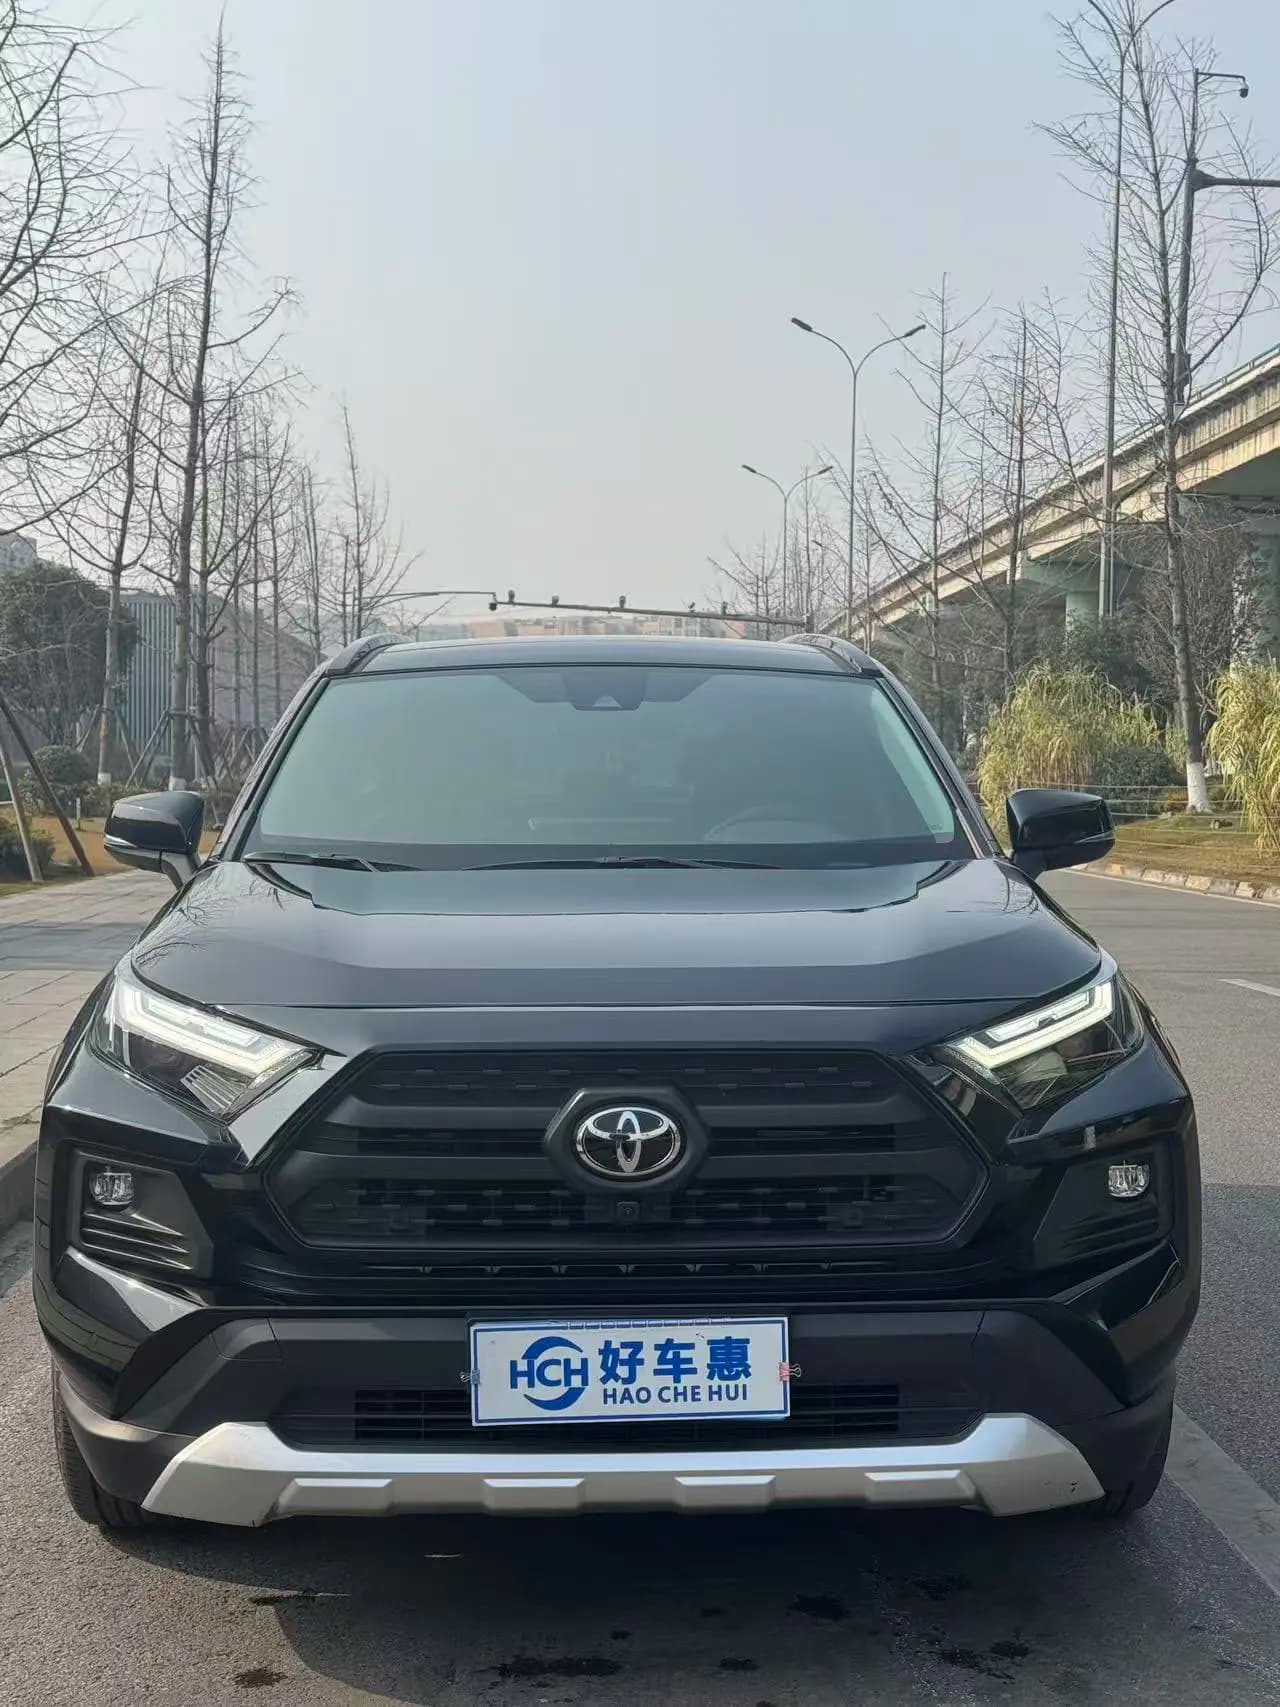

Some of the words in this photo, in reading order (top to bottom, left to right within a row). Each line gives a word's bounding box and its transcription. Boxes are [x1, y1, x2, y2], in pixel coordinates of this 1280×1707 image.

[509, 1357, 590, 1389] HCH
[598, 1336, 752, 1385] 好车惠
[602, 1386, 652, 1405] HAO
[657, 1385, 702, 1403] CHE
[707, 1383, 748, 1402] HUI
